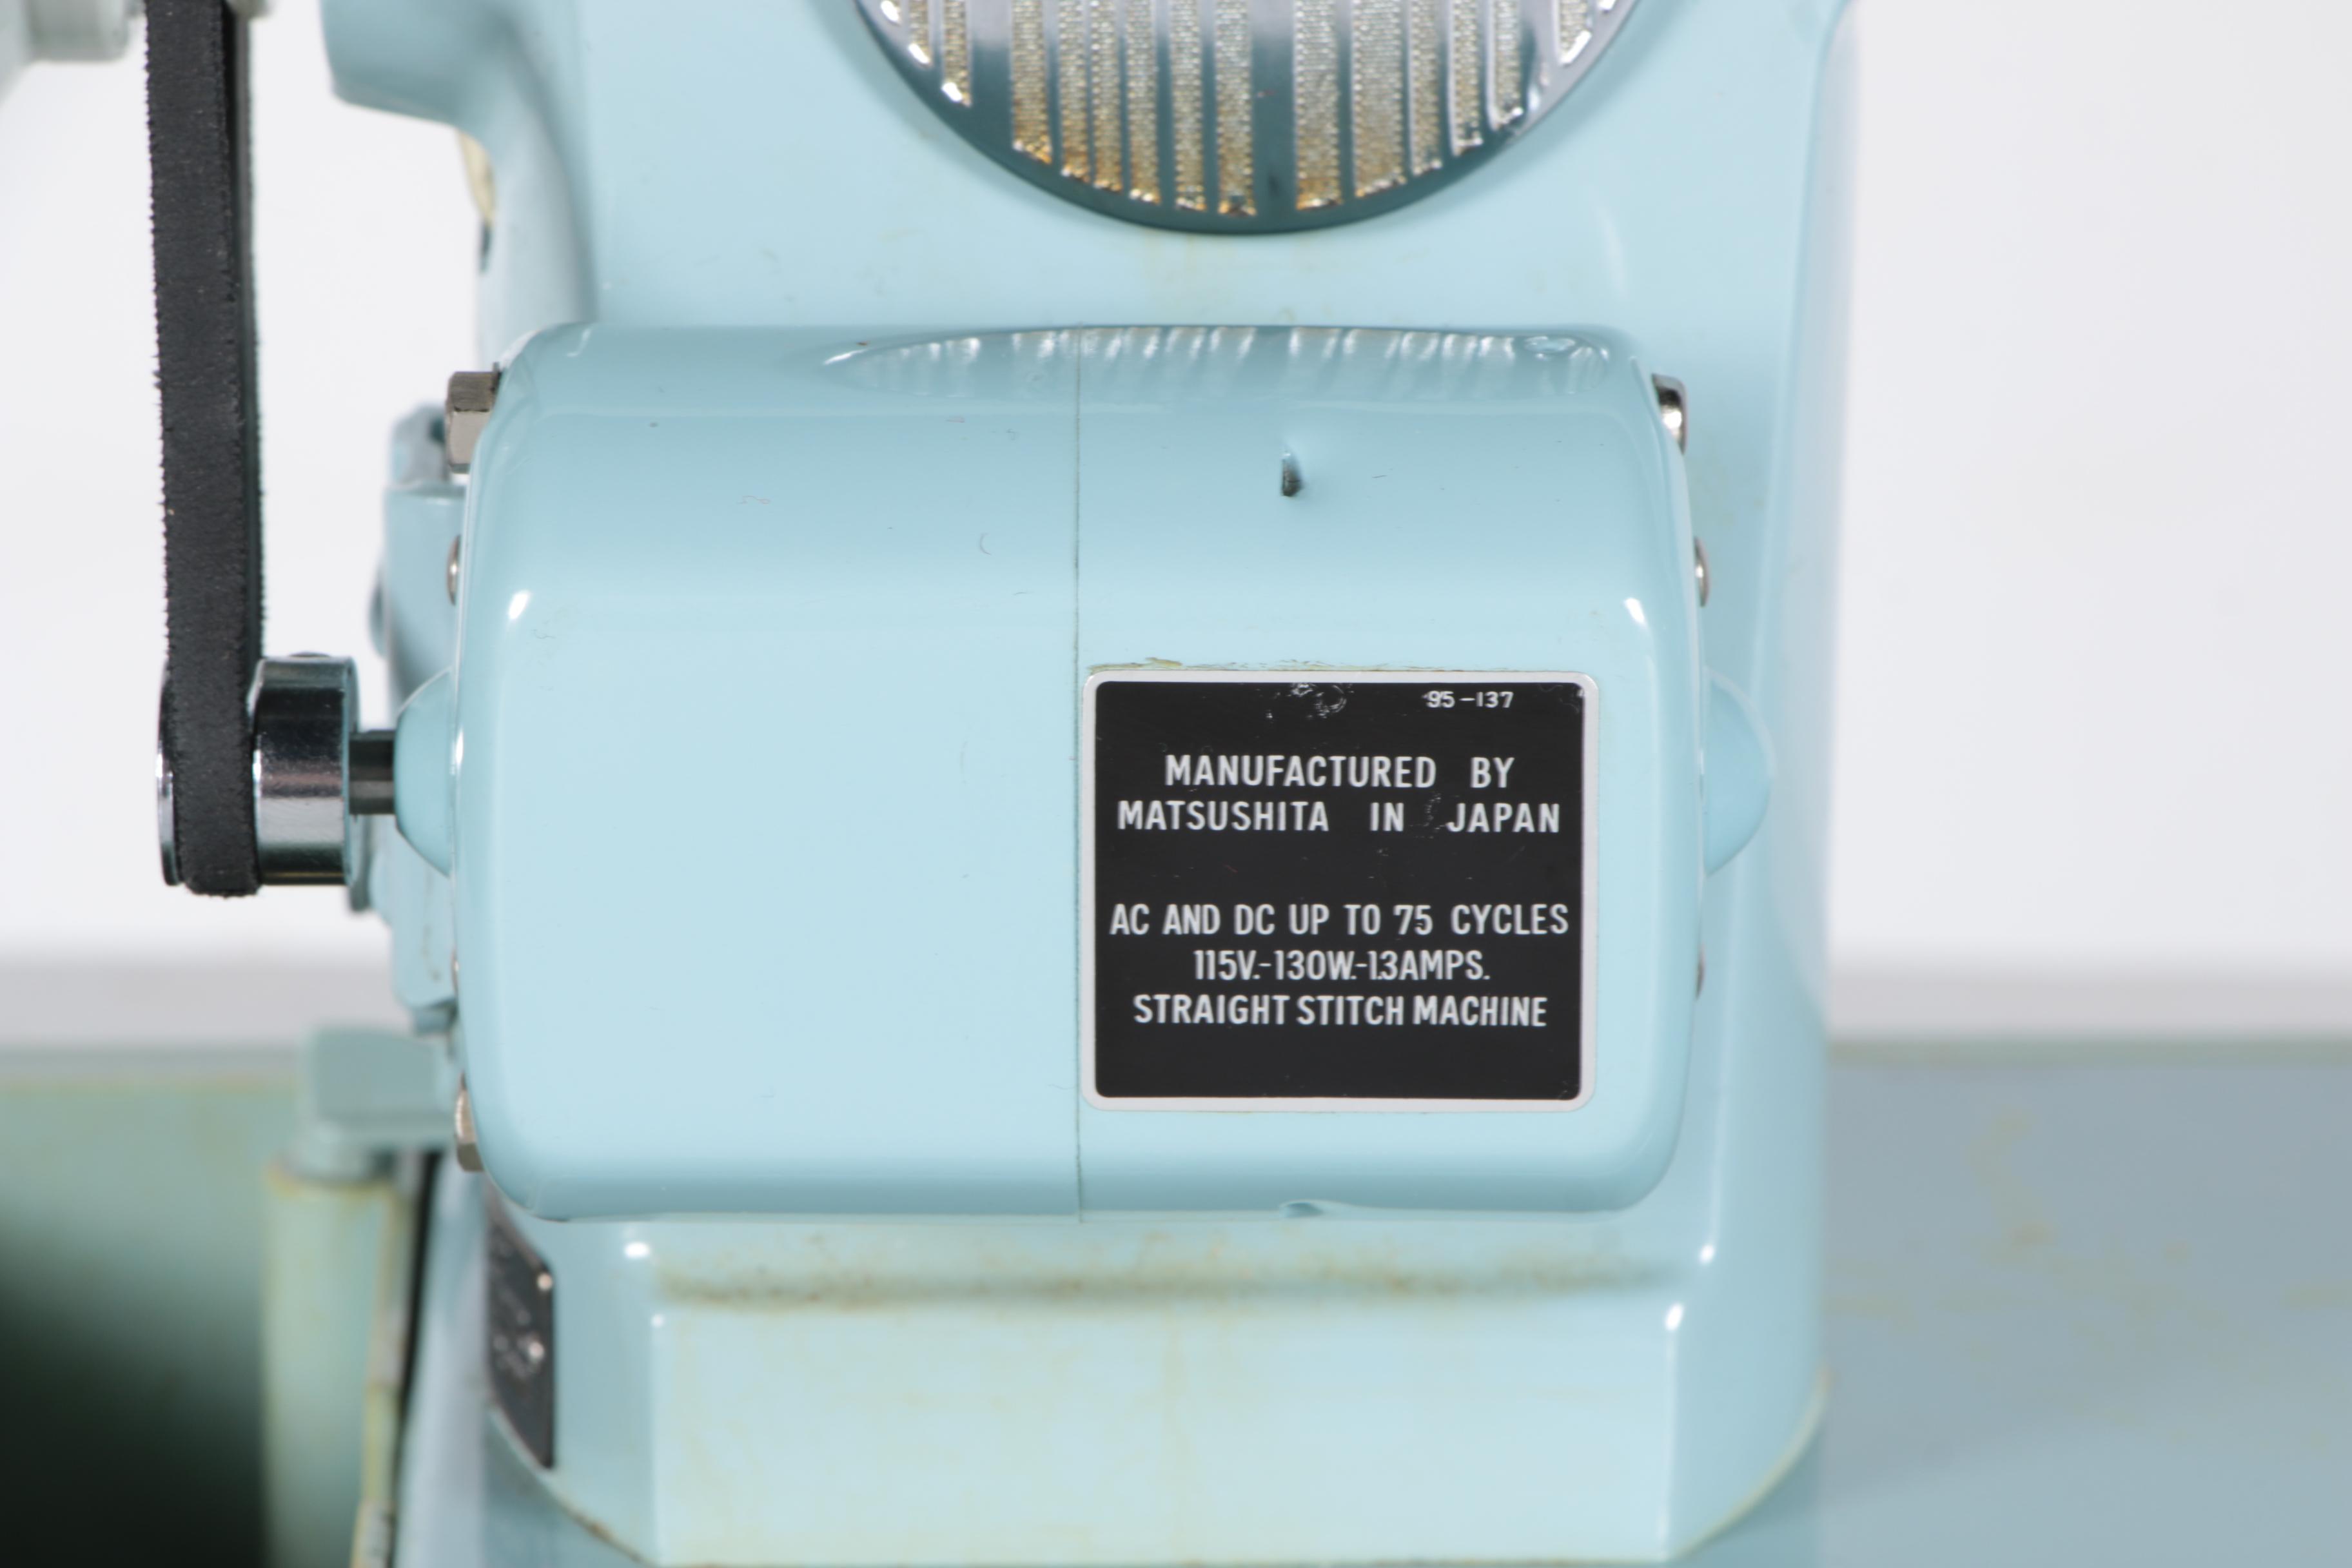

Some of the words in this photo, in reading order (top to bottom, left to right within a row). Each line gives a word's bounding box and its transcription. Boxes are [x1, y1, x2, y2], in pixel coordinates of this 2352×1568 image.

[1166, 754, 1436, 789] MANUFACTURED
[1471, 756, 1515, 789] BY
[1118, 799, 1329, 832] MATSUSHITA
[1370, 802, 1404, 832] IN
[1446, 802, 1560, 833] JAPAN
[1110, 903, 1150, 936] AC
[1162, 903, 1221, 935] AND
[1234, 903, 1275, 936] DC
[1289, 903, 1329, 935] UP
[1344, 903, 1381, 936] TO
[1393, 904, 1433, 936] 75
[1451, 903, 1569, 936] CYCLES
[1133, 994, 1291, 1025] STRAIGHT
[1297, 995, 1404, 1026] STITCH
[1413, 995, 1548, 1027] MACHINE
